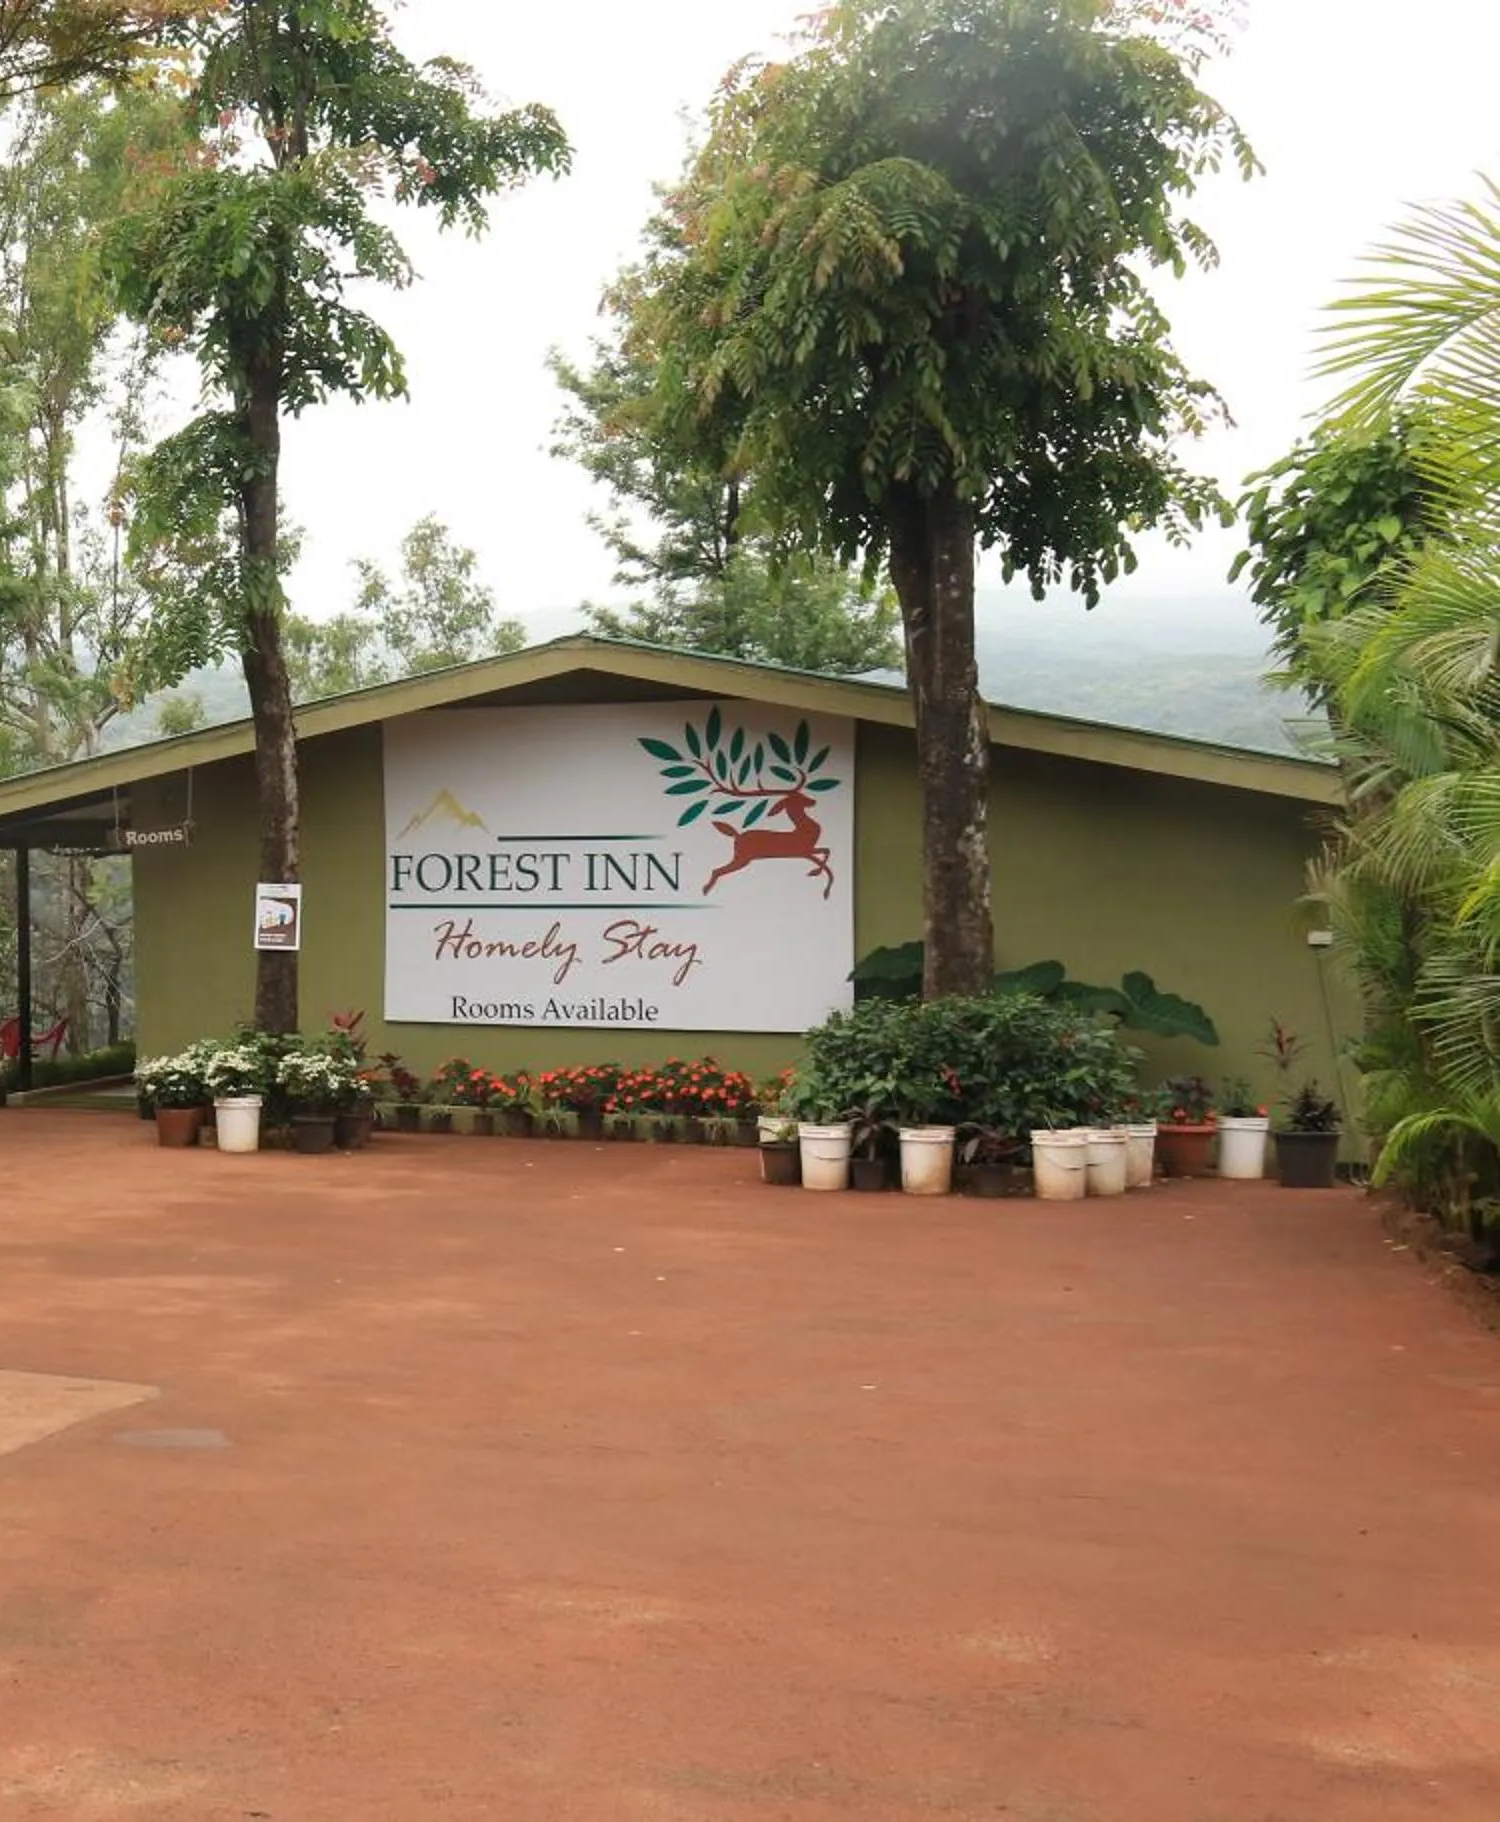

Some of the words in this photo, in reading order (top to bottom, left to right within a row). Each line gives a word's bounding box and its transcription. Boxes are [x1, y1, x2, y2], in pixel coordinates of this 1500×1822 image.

[124, 828, 183, 845] Rooms
[389, 852, 571, 892] FOREST
[583, 851, 684, 892] INN
[433, 917, 583, 986] Homely
[601, 918, 703, 987] Stay
[451, 995, 536, 1020] Rooms
[541, 997, 659, 1022] Available
